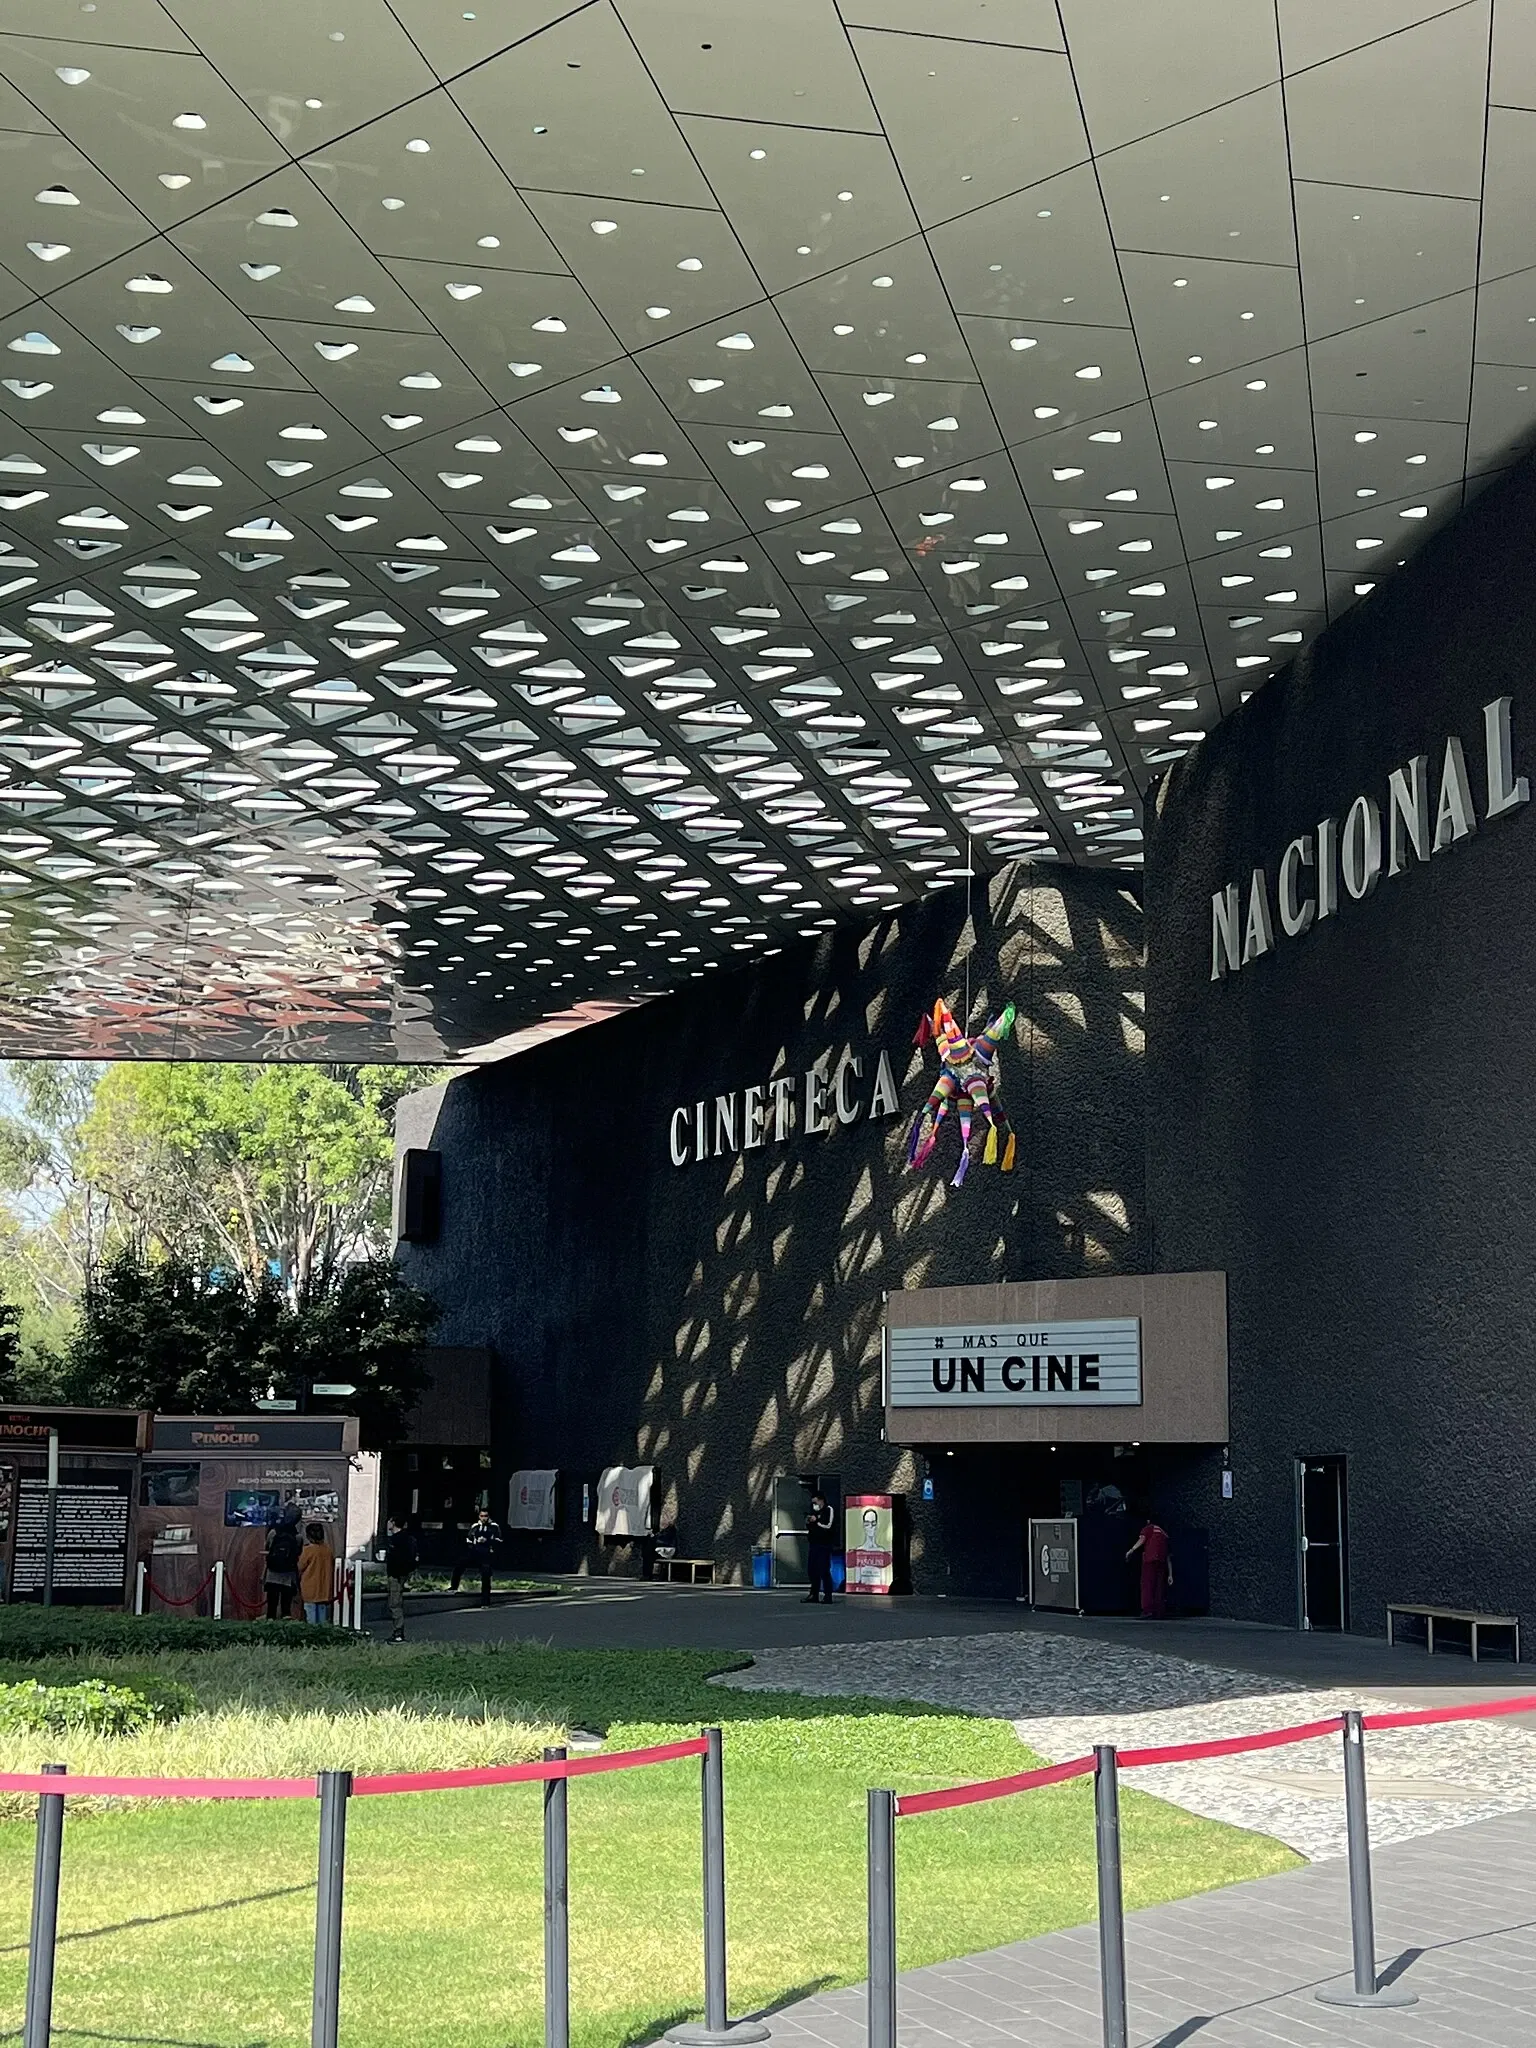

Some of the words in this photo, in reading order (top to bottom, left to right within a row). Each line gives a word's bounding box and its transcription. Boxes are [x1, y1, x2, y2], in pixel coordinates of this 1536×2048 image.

[1209, 696, 1531, 982] NACIONAL
[668, 1049, 901, 1168] CINETECA
[962, 1334, 998, 1349] MAS
[1016, 1332, 1049, 1347] QUE
[932, 1356, 985, 1393] UN
[1001, 1353, 1100, 1392] CINE
[190, 1431, 261, 1444] PINOCHO
[265, 1469, 304, 1478] PINOCHO
